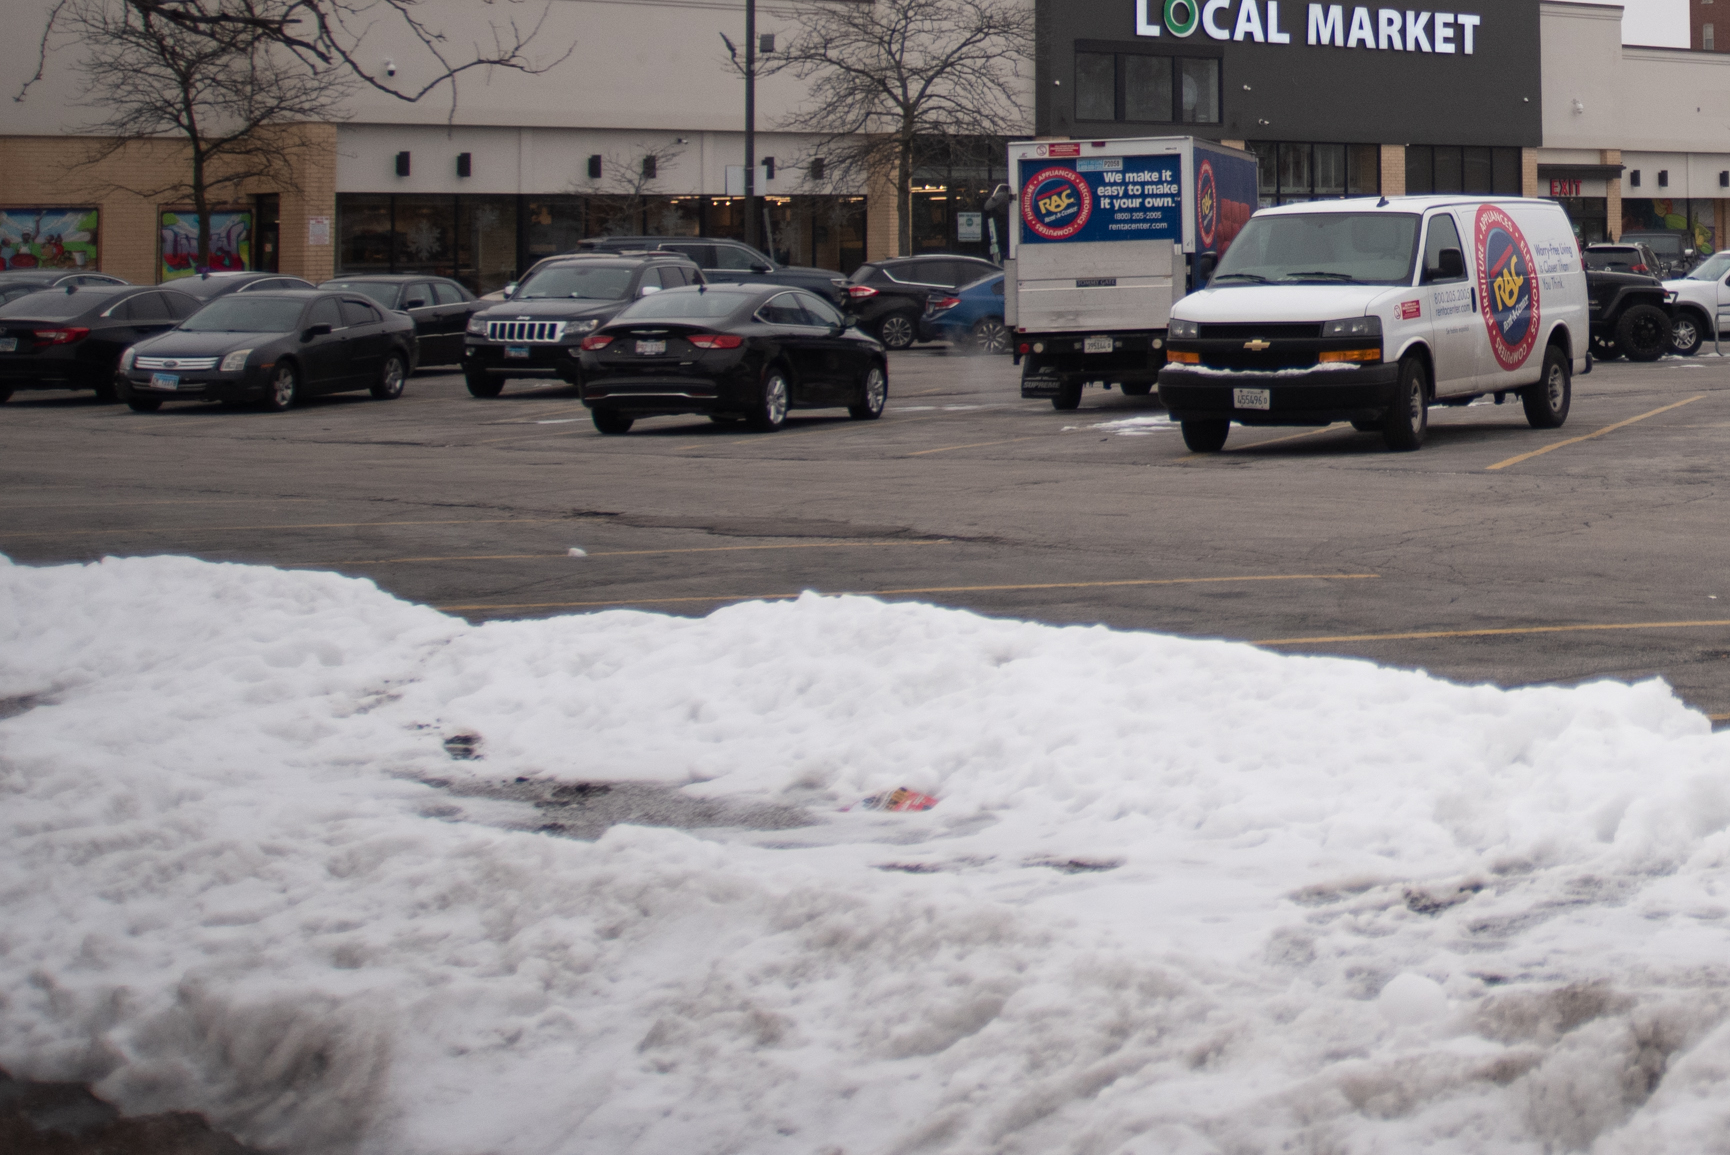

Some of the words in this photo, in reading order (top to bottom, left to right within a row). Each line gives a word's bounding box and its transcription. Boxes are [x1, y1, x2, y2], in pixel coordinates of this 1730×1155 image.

[1307, 3, 1481, 55] MARKET
[1038, 169, 1076, 181] APPLIANCES
[1103, 172, 1123, 183] We
[1125, 170, 1159, 183] make
[1161, 169, 1172, 181] it
[1097, 186, 1125, 197] easy
[1127, 184, 1142, 195] to
[1144, 183, 1178, 194] make
[1550, 179, 1582, 195] EXIT
[1024, 184, 1035, 220] FURNITURE
[1038, 189, 1074, 214] RAC
[1078, 182, 1090, 225] ELECTRONICS
[1100, 197, 1111, 209] it
[1113, 198, 1142, 210] your
[1114, 212, 1131, 220] (800)
[1132, 211, 1162, 219] 205-2005
[1479, 210, 1513, 235] APPLIANCES
[1035, 223, 1074, 236] COMPUTERS
[1108, 222, 1168, 231] rentacenter.com
[1558, 242, 1573, 258] Living
[1477, 242, 1493, 326] FURNITURE
[1493, 254, 1524, 312] RAC
[1520, 240, 1539, 335] ELECTRONICS
[1542, 277, 1551, 290] You
[1435, 303, 1471, 316] rentacenter.com
[1495, 337, 1527, 364] COMPUTERS
[1023, 381, 1061, 389] SUPREME
[1237, 395, 1262, 405] 455496
